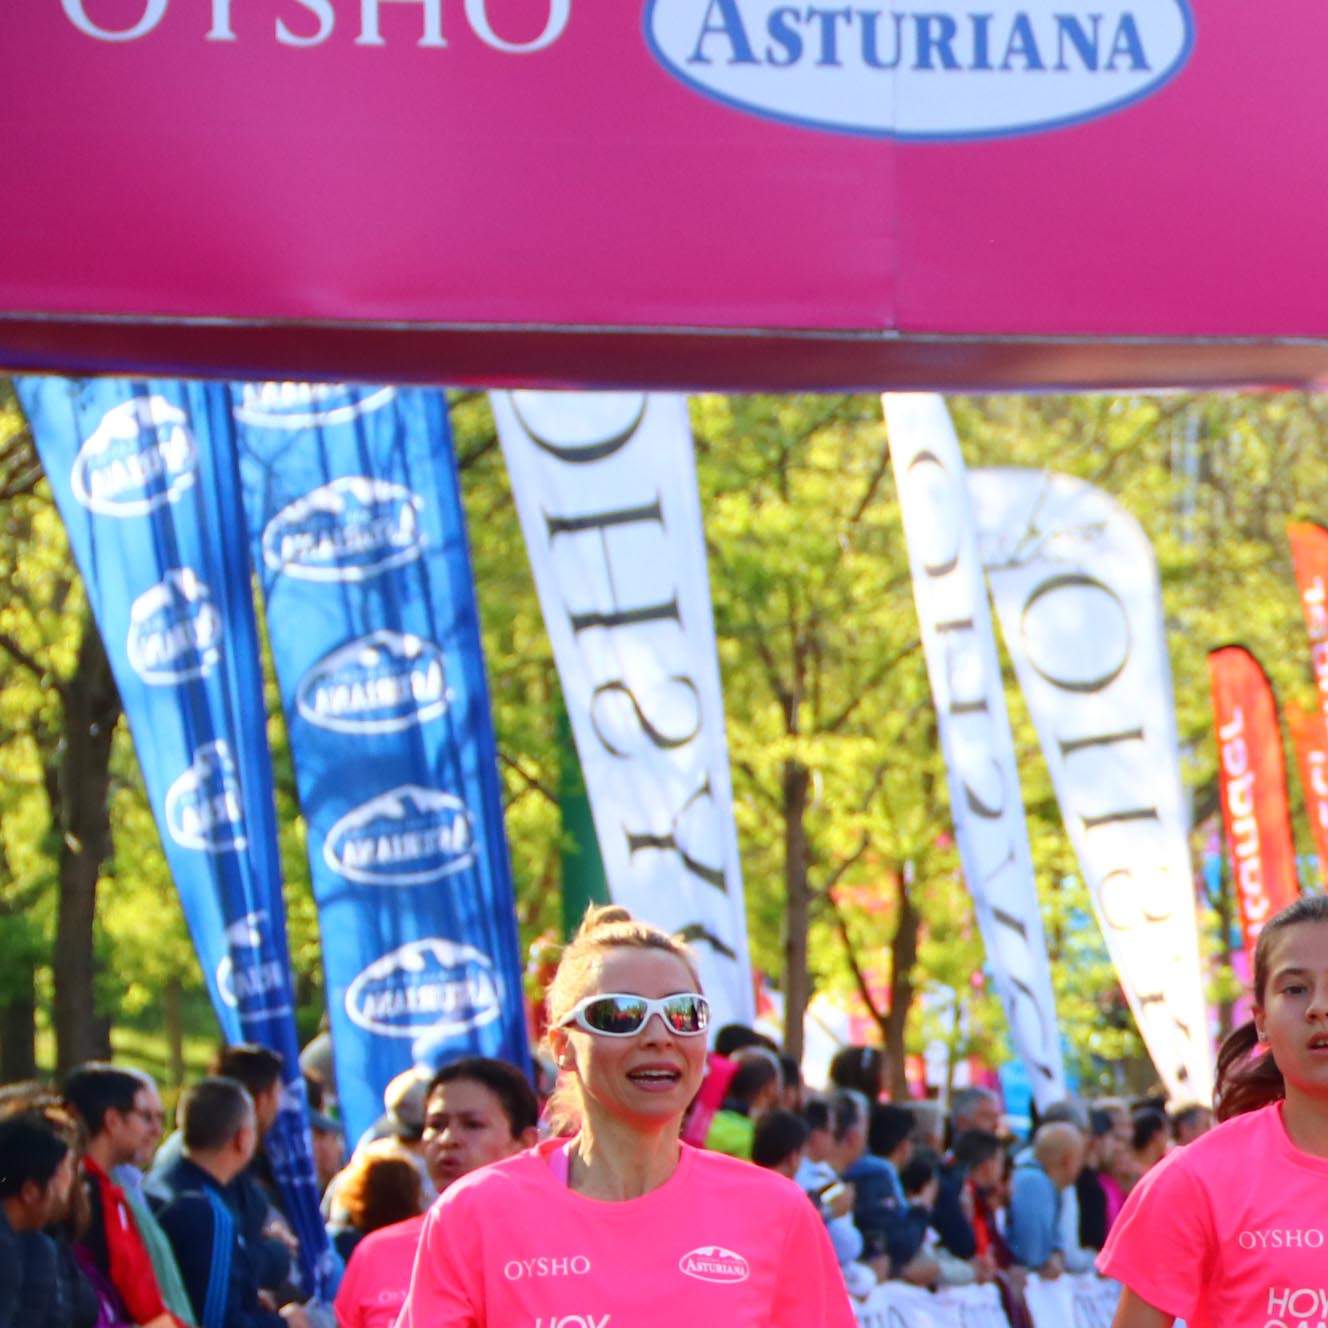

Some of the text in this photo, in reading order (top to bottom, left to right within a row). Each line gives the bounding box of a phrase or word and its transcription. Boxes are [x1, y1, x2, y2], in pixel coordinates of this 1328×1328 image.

[688, 0, 1153, 73] ASTURIANA
[1238, 1229, 1324, 1249] OYSHO
[504, 1256, 591, 1281] OYSHO
